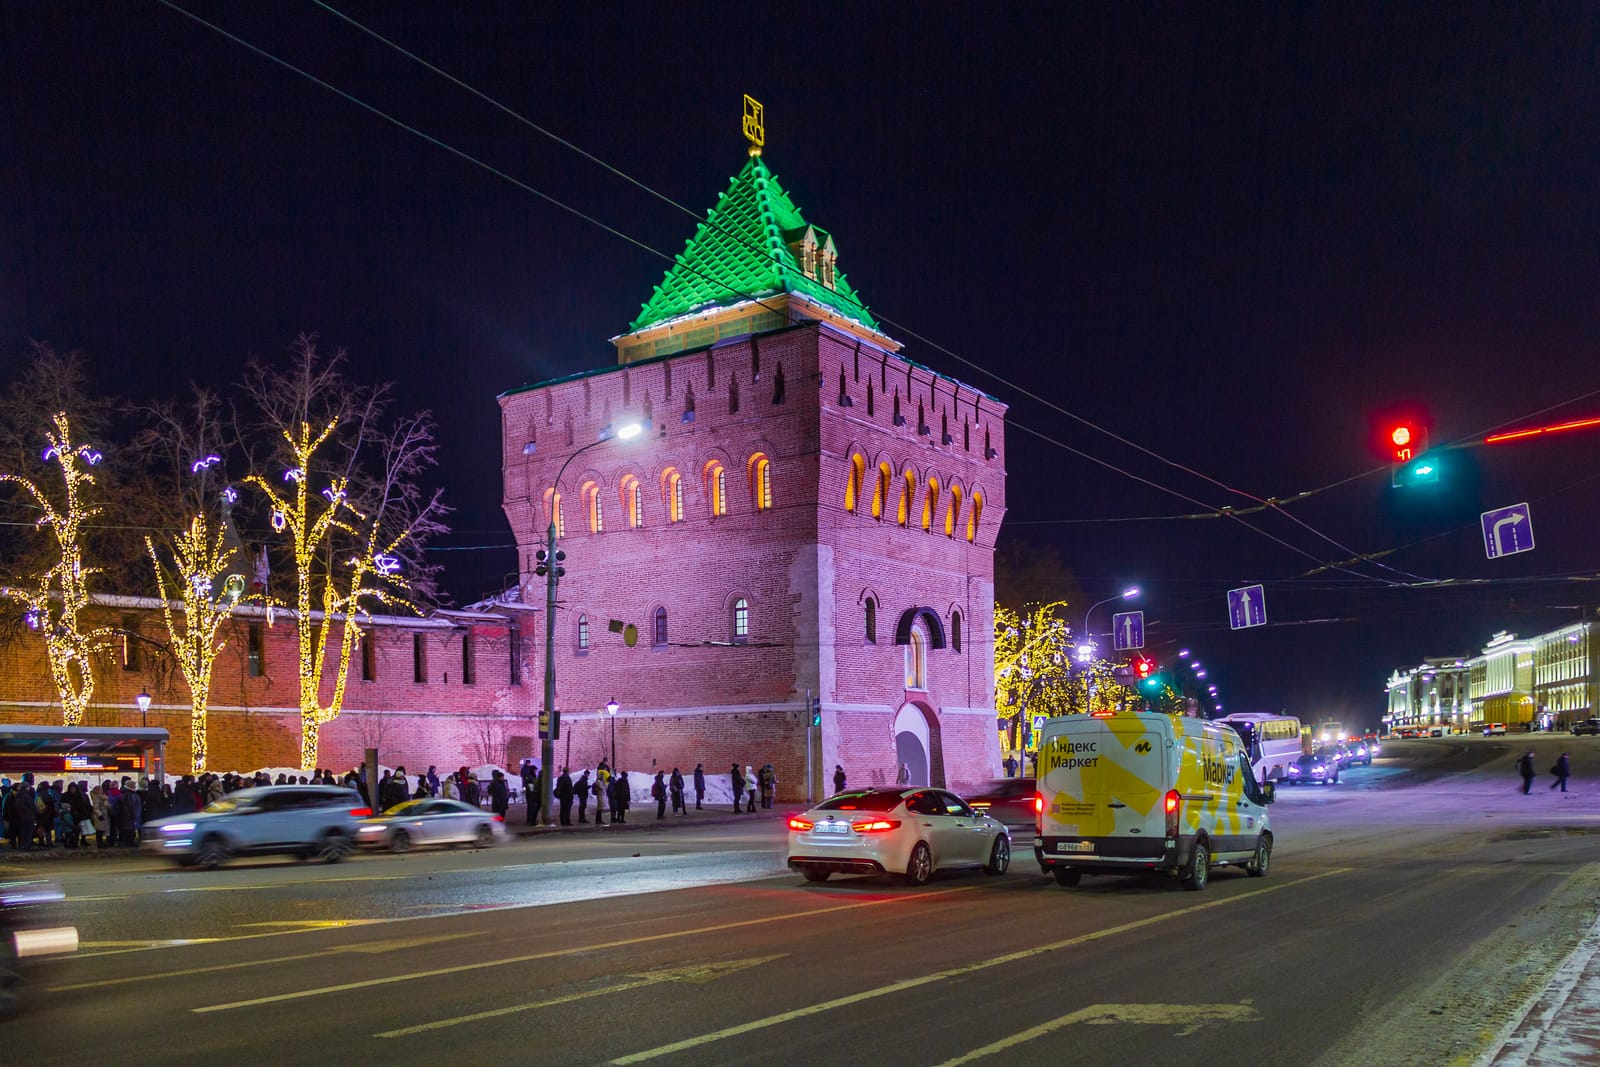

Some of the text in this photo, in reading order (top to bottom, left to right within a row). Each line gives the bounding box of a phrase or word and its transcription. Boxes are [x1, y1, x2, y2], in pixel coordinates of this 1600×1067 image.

[1397, 448, 1411, 461] 47
[1051, 740, 1097, 754] Яндекс
[1050, 755, 1099, 770] Маркет
[1202, 754, 1235, 788] Маркет
